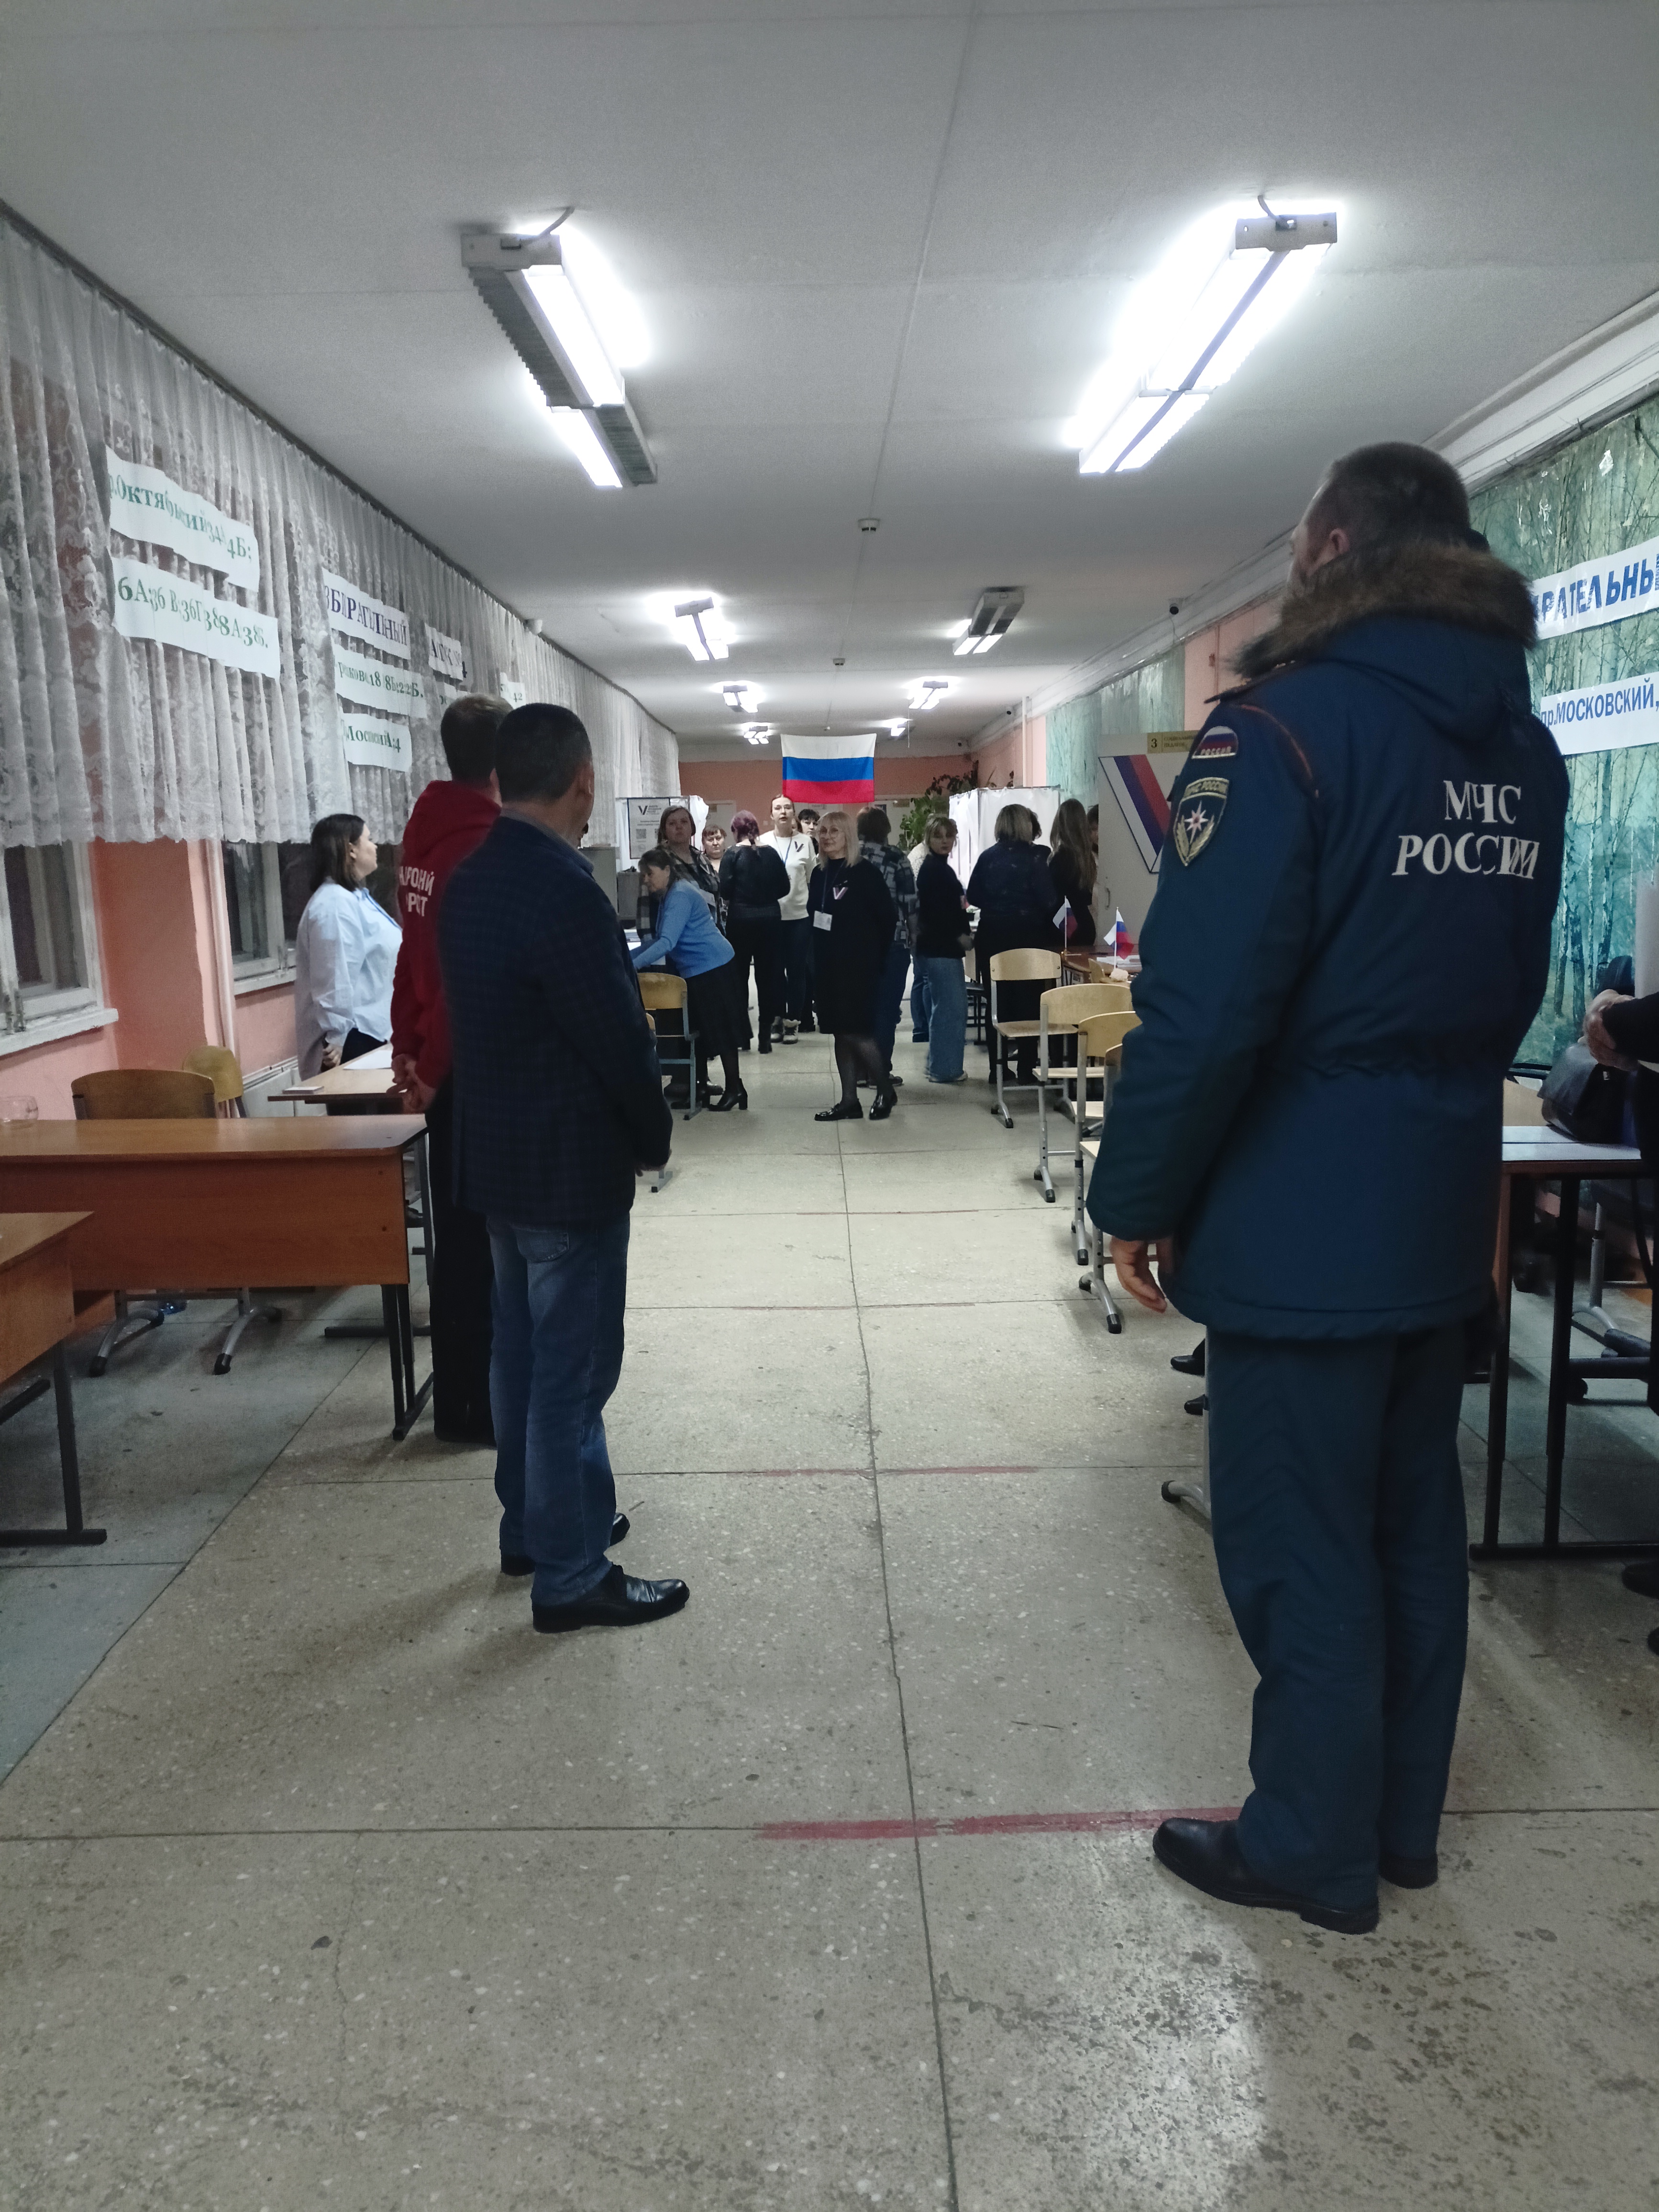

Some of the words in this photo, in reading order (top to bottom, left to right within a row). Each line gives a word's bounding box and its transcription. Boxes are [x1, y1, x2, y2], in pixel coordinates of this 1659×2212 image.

[1151, 738, 1157, 749] 3
[1443, 780, 1521, 824] МЧС
[1391, 832, 1540, 880] РОССИИ
